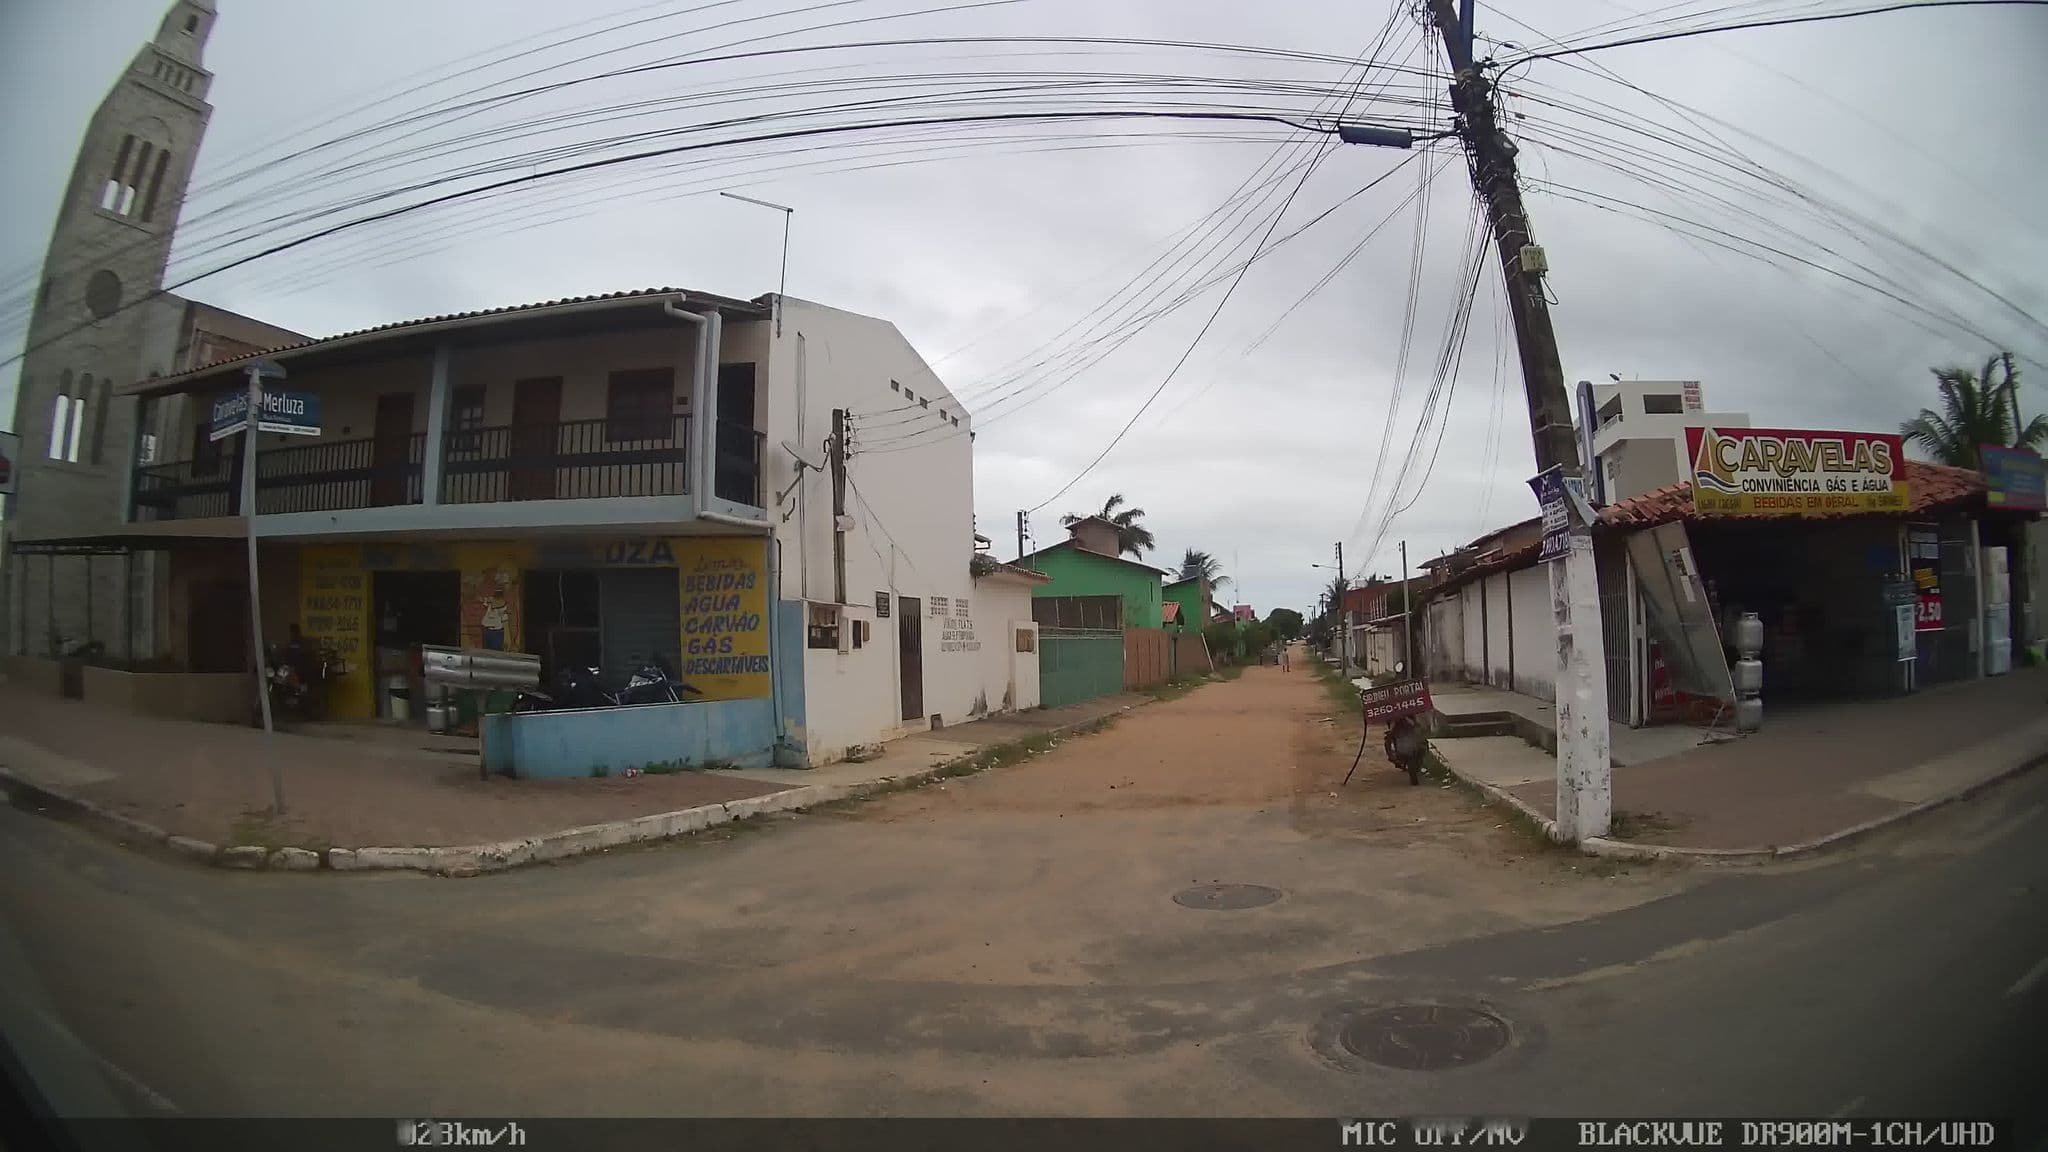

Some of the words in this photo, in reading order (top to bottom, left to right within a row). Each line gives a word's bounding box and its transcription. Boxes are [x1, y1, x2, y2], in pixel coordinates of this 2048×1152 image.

[264, 393, 304, 415] Merluza
[1715, 438, 1892, 477] CARAVELAS
[1826, 475, 1847, 492] GÁS
[1851, 479, 1858, 492] E
[1862, 476, 1889, 491] ÁGUA
[1753, 495, 1803, 509] BEBIDAS
[1807, 495, 1822, 509] EM
[1825, 495, 1858, 509] GERAL
[685, 572, 756, 592] BEBIDAS
[1366, 697, 1425, 718] 3260-1445
